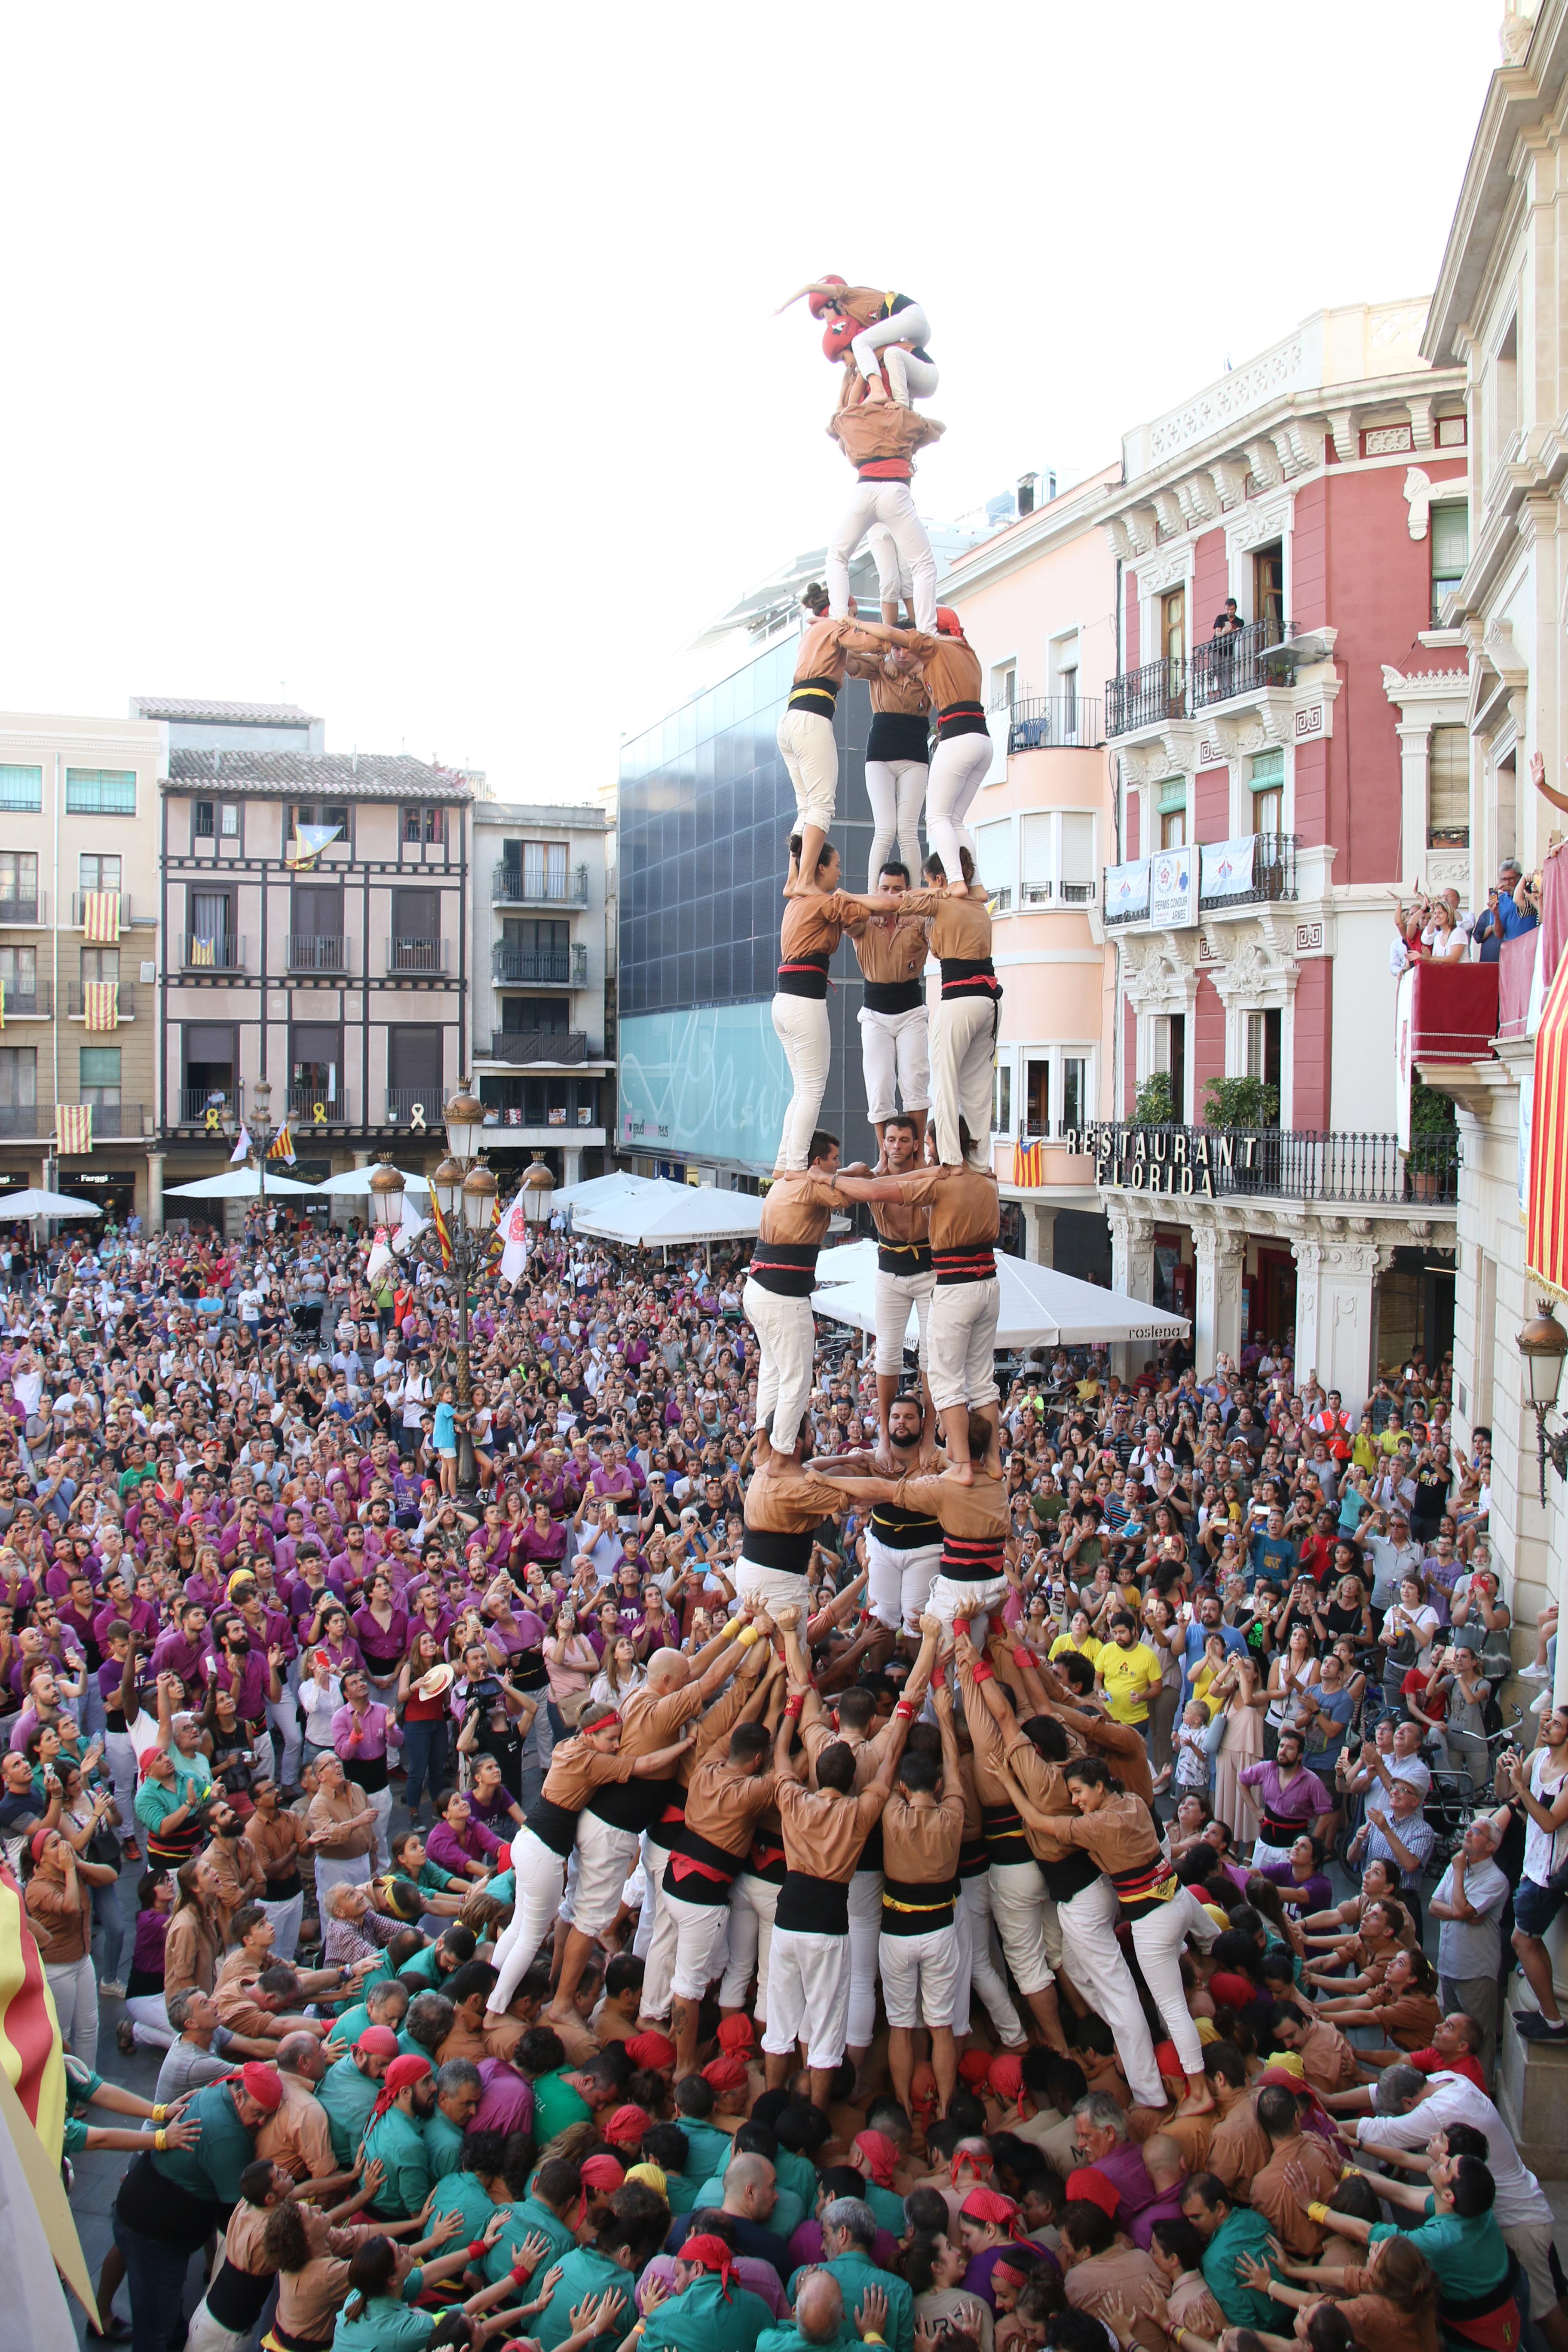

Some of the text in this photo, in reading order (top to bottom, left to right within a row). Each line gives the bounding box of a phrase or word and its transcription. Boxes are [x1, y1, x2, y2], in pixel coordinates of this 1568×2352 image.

[1170, 896, 1187, 908] CONDUIR
[1172, 909, 1186, 921] ARMES
[1066, 1128, 1258, 1168] RESTAURANT
[80, 1174, 109, 1183] Farggi
[1096, 1160, 1215, 1198] FLORIDA
[691, 1230, 745, 1240] BATTICUORE
[1129, 1325, 1180, 1338] roslena
